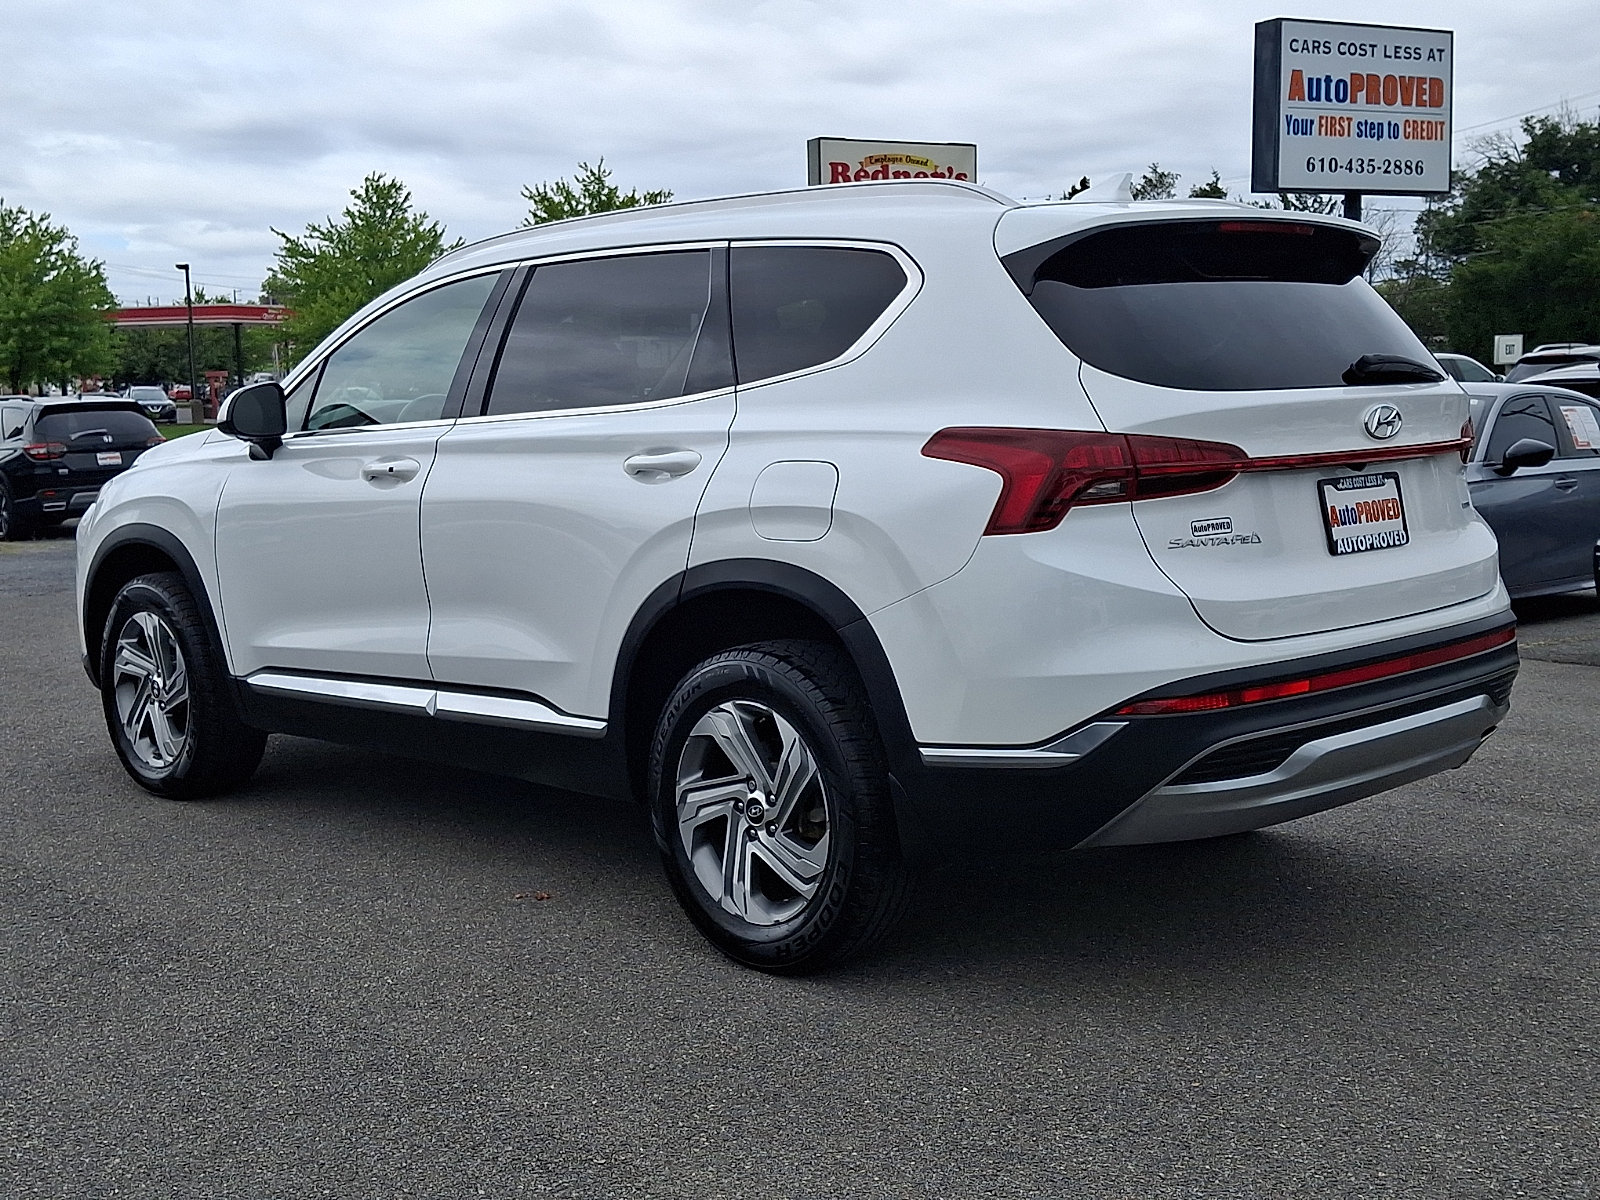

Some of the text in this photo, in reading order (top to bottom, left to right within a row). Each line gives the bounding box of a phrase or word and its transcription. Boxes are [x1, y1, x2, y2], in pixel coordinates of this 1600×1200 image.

[1289, 38, 1445, 62] CARS COST LESS AT
[1288, 69, 1444, 108] AutoPROVED
[1285, 114, 1445, 141] Your FIRST step to CREDIT
[868, 154, 929, 167] Employee Owned
[1306, 156, 1424, 176] 610-435-2886
[1505, 344, 1516, 356] EXIT
[1340, 478, 1353, 489] CARS
[1353, 476, 1366, 488] COST
[1365, 475, 1378, 487] LESS
[1330, 498, 1401, 528] AutoPROVED
[1193, 521, 1231, 533] AutoPROVED
[1337, 530, 1407, 554] AUTOPROVED
